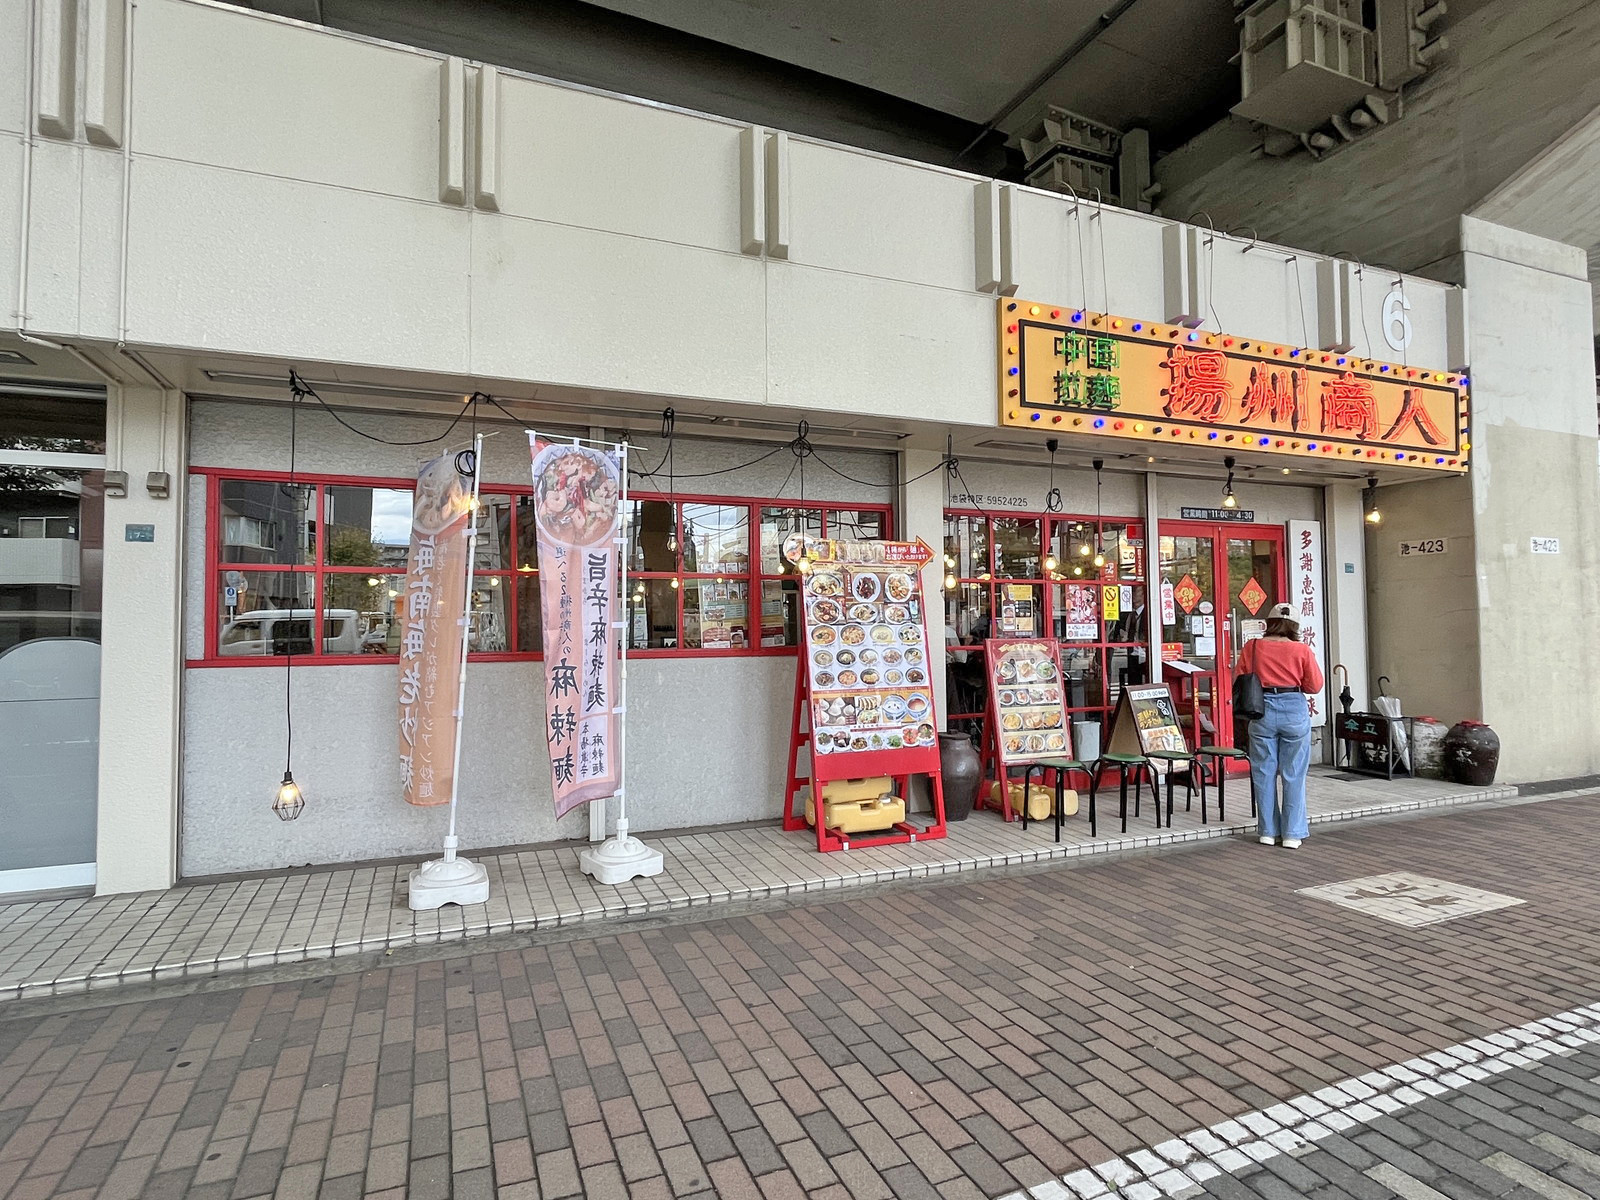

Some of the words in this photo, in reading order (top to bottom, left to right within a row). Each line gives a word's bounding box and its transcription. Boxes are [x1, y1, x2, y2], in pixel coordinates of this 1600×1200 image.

[1381, 291, 1413, 352] 6
[1158, 344, 1449, 445] 揚州商人
[1400, 540, 1444, 556] 池-423
[1532, 538, 1558, 553] 池-423
[1162, 587, 1174, 621] 営業中
[1344, 718, 1378, 736] 傘立
